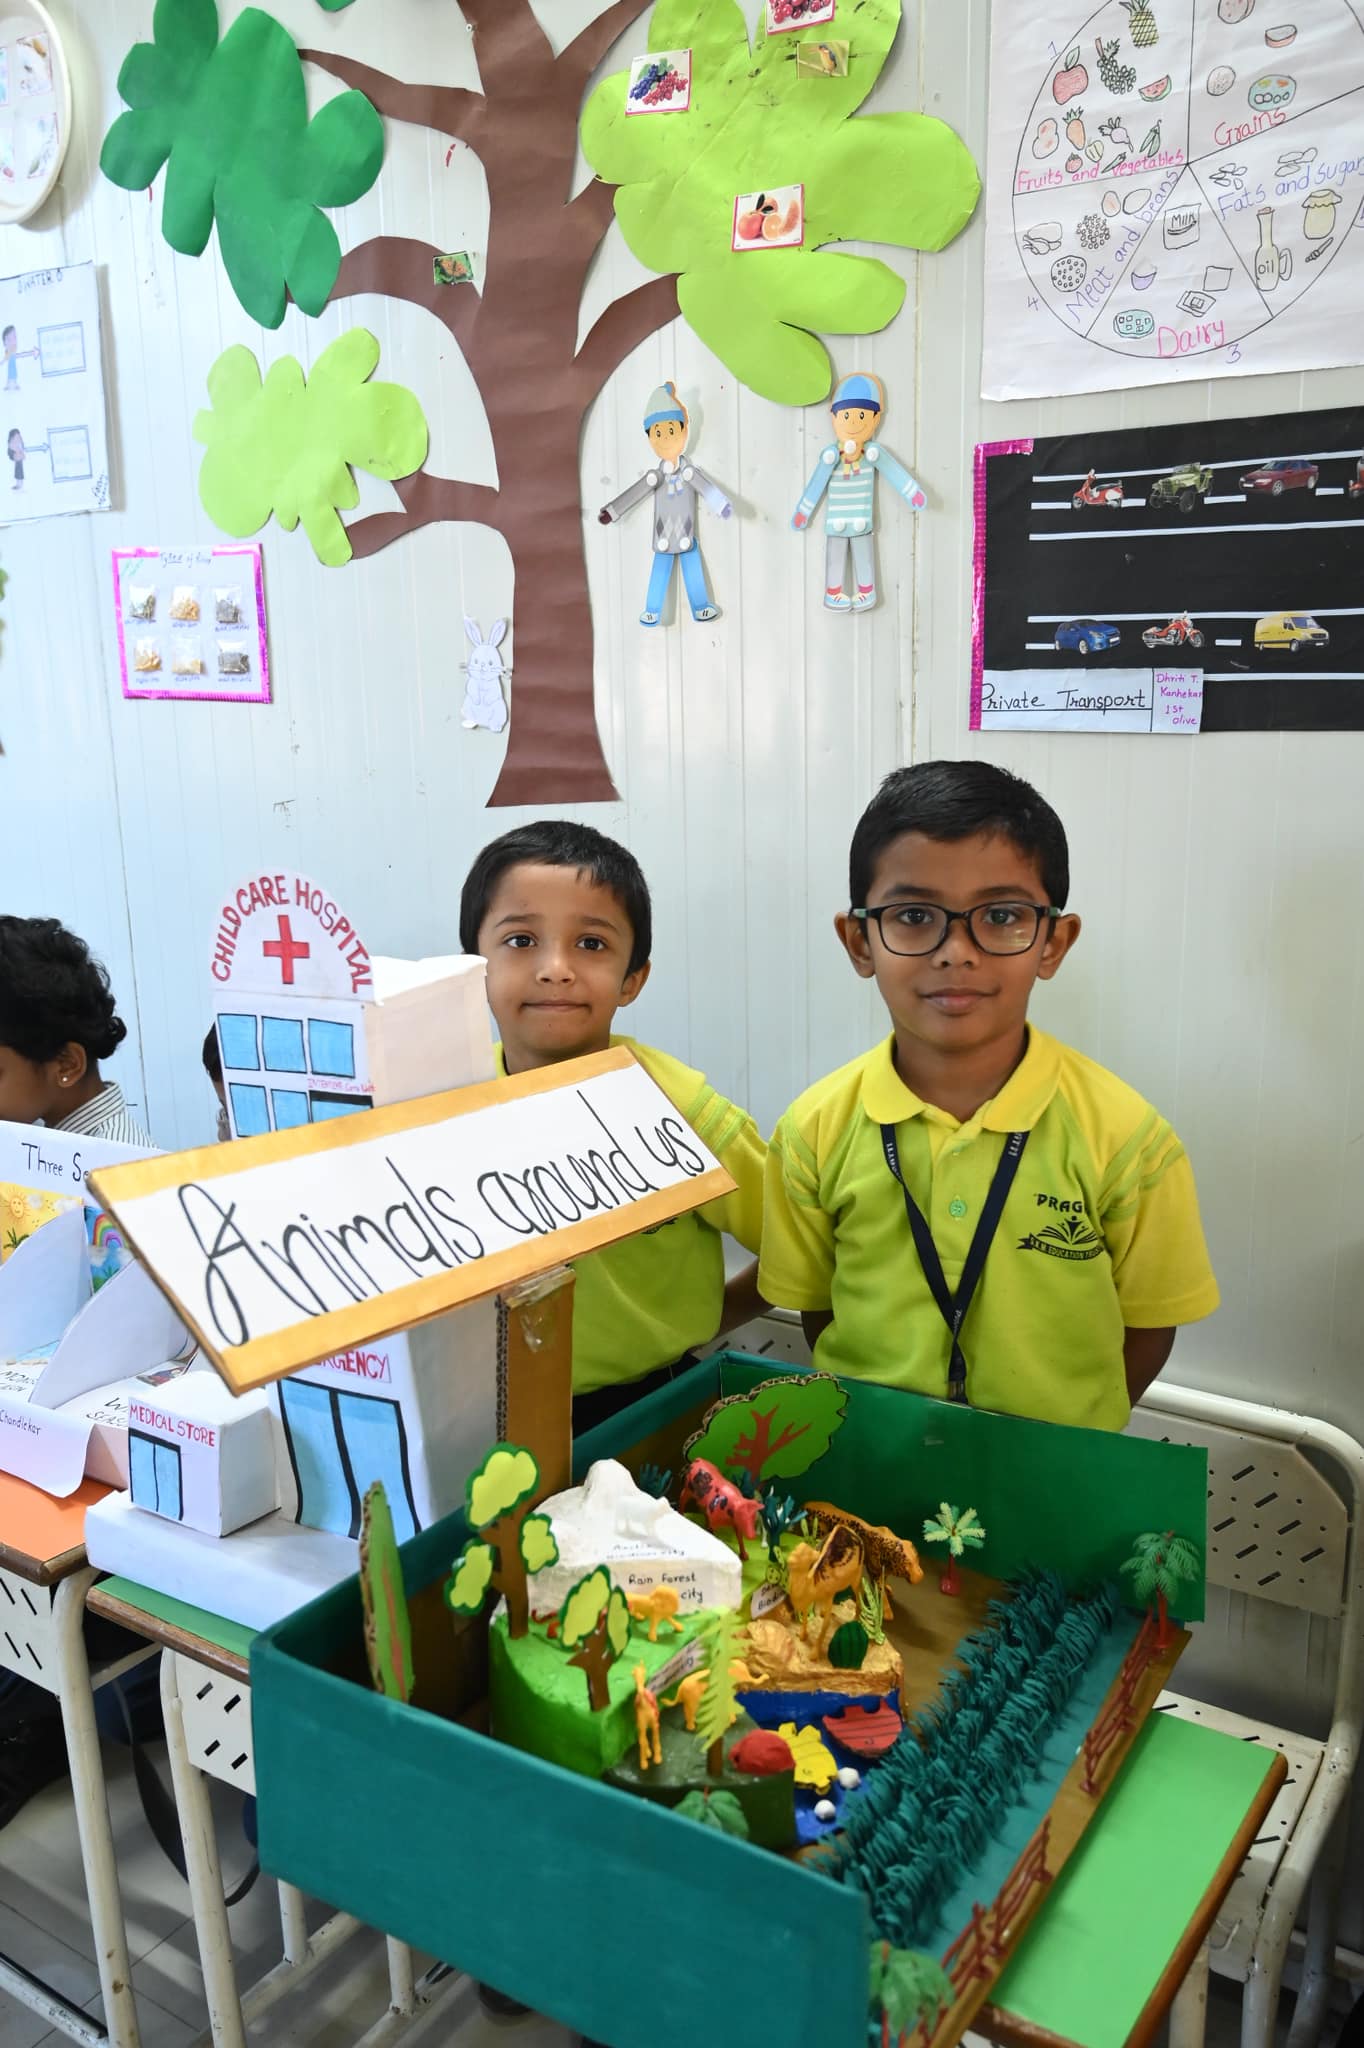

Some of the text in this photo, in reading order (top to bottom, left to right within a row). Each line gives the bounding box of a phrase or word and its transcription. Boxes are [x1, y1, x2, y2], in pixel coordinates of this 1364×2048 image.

[1213, 109, 1288, 147] Grains
[1017, 150, 1186, 193] Fruits and vegetables
[1217, 188, 1267, 221] Fats
[1275, 170, 1312, 196] and
[1065, 170, 1182, 324] Meat and beans
[1257, 262, 1277, 275] oil
[1156, 320, 1226, 359] Dairy
[1226, 345, 1243, 365] 3
[981, 683, 1147, 716] Private Transport
[296, 878, 374, 994] HOSPITAL
[21, 1142, 63, 1176] Three
[178, 1089, 705, 1347] Animals around us
[130, 1404, 174, 1433] MEDICAL
[177, 1420, 215, 1447] STORE
[629, 1571, 696, 1585] Rain Forest
[681, 1588, 703, 1603] city
